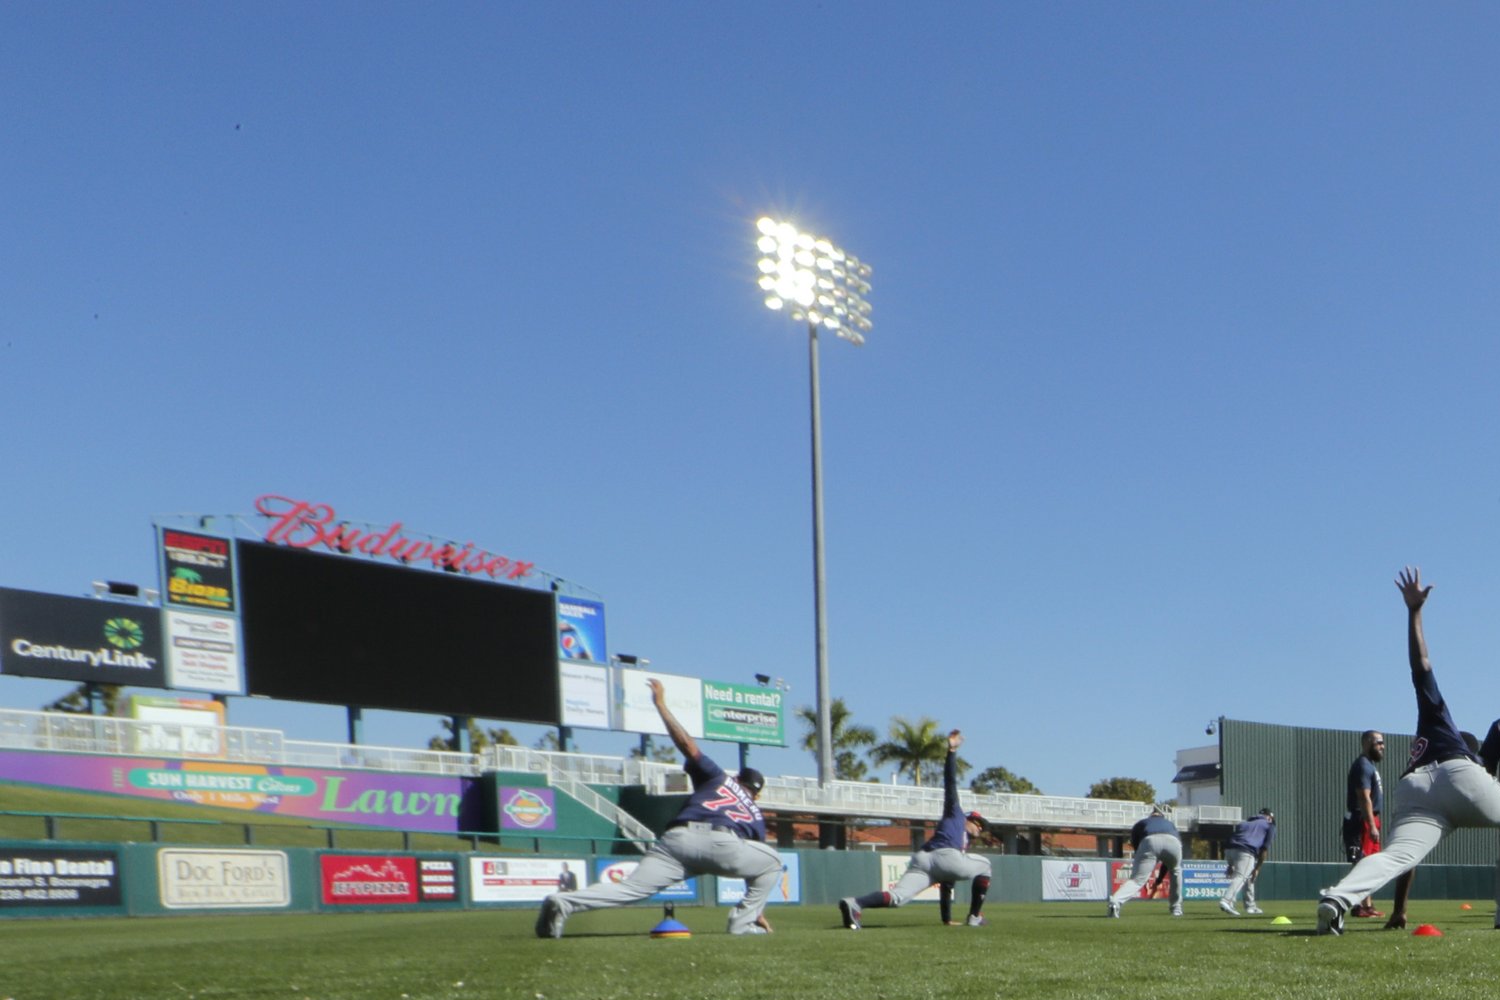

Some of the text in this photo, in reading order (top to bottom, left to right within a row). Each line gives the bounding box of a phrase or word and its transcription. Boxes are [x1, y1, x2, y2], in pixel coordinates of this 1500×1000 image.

[255, 494, 534, 580] Budweiser
[11, 638, 155, 669] CenturyLink
[704, 684, 781, 708] Need a rental?
[711, 709, 777, 723] enterprise
[147, 772, 182, 786] SUN
[186, 773, 253, 790] HARVEST
[320, 776, 462, 817] Lawn
[176, 860, 275, 886] DOC FORD'S
